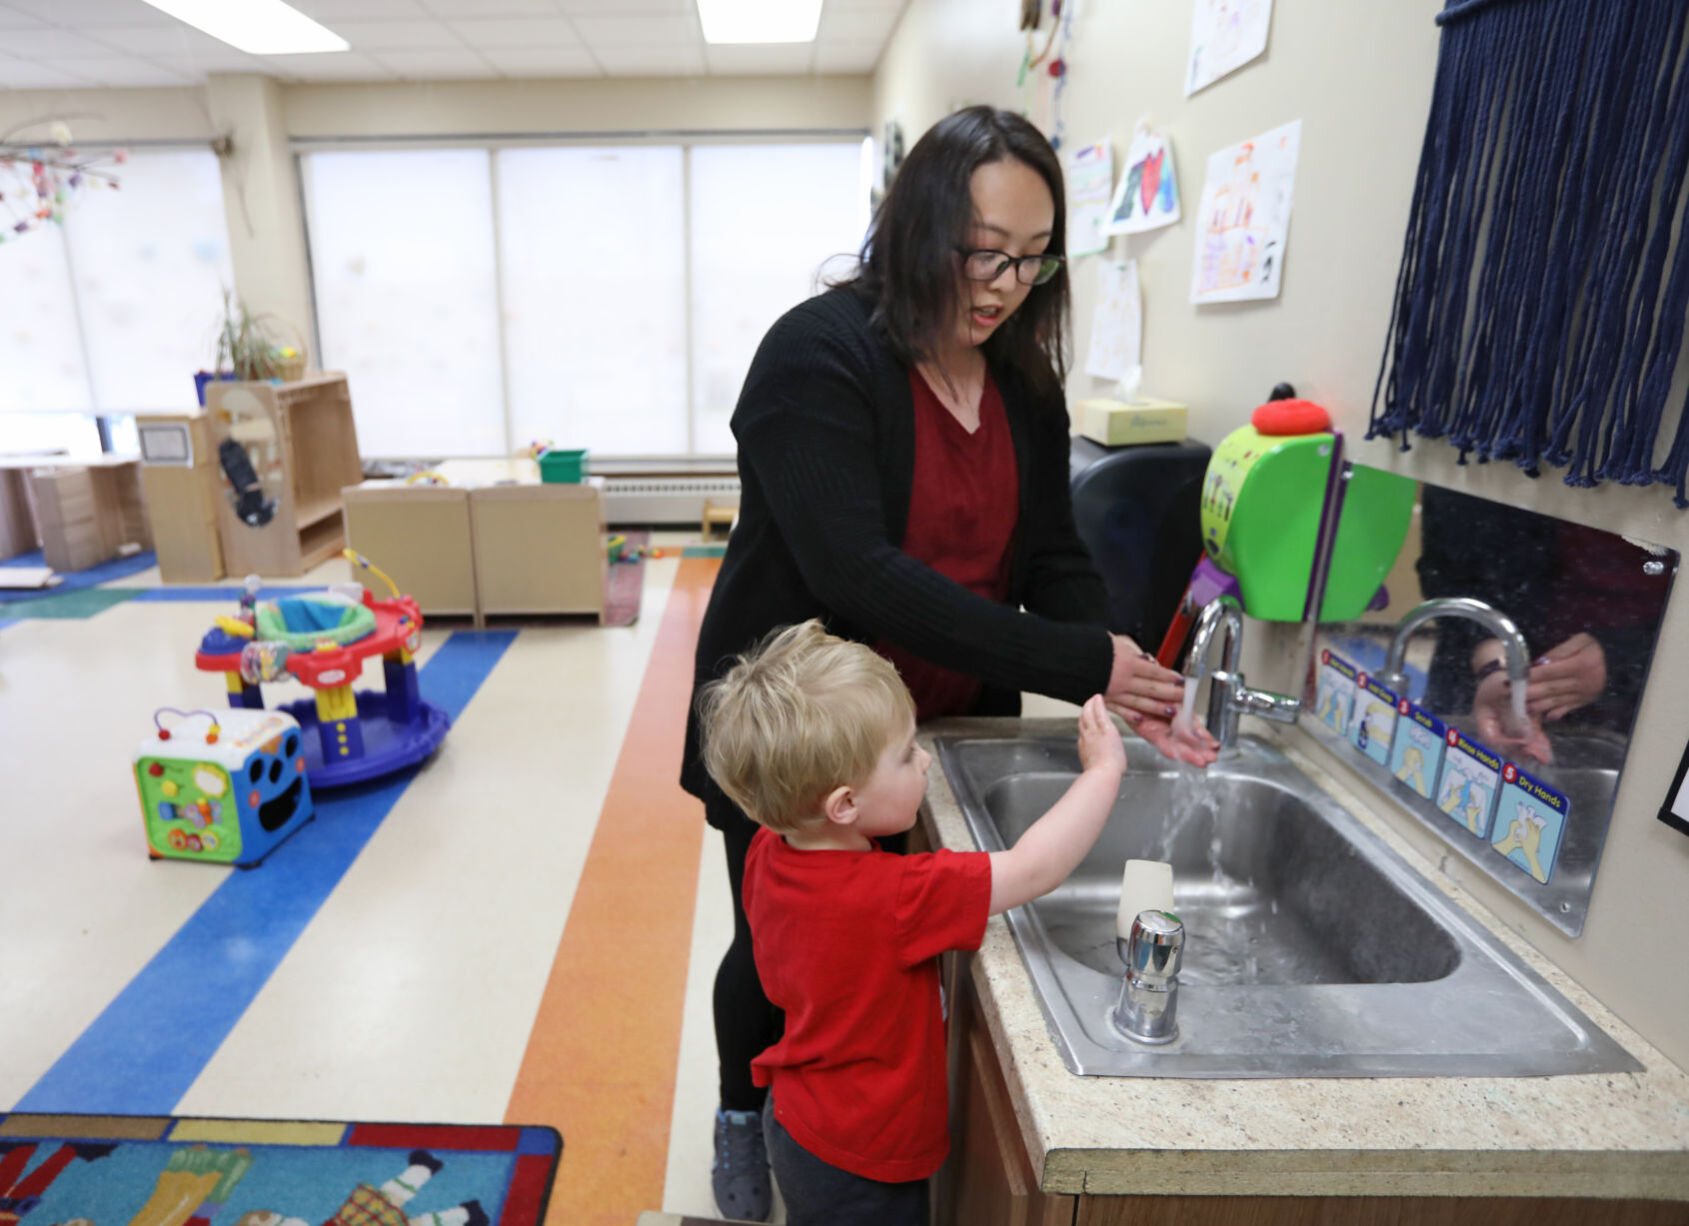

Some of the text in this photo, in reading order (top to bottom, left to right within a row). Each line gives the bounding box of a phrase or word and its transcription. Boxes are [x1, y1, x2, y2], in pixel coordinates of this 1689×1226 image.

[1476, 749, 1499, 770] Hands
[1519, 776, 1534, 792] Dry
[1534, 785, 1561, 808] Hands
